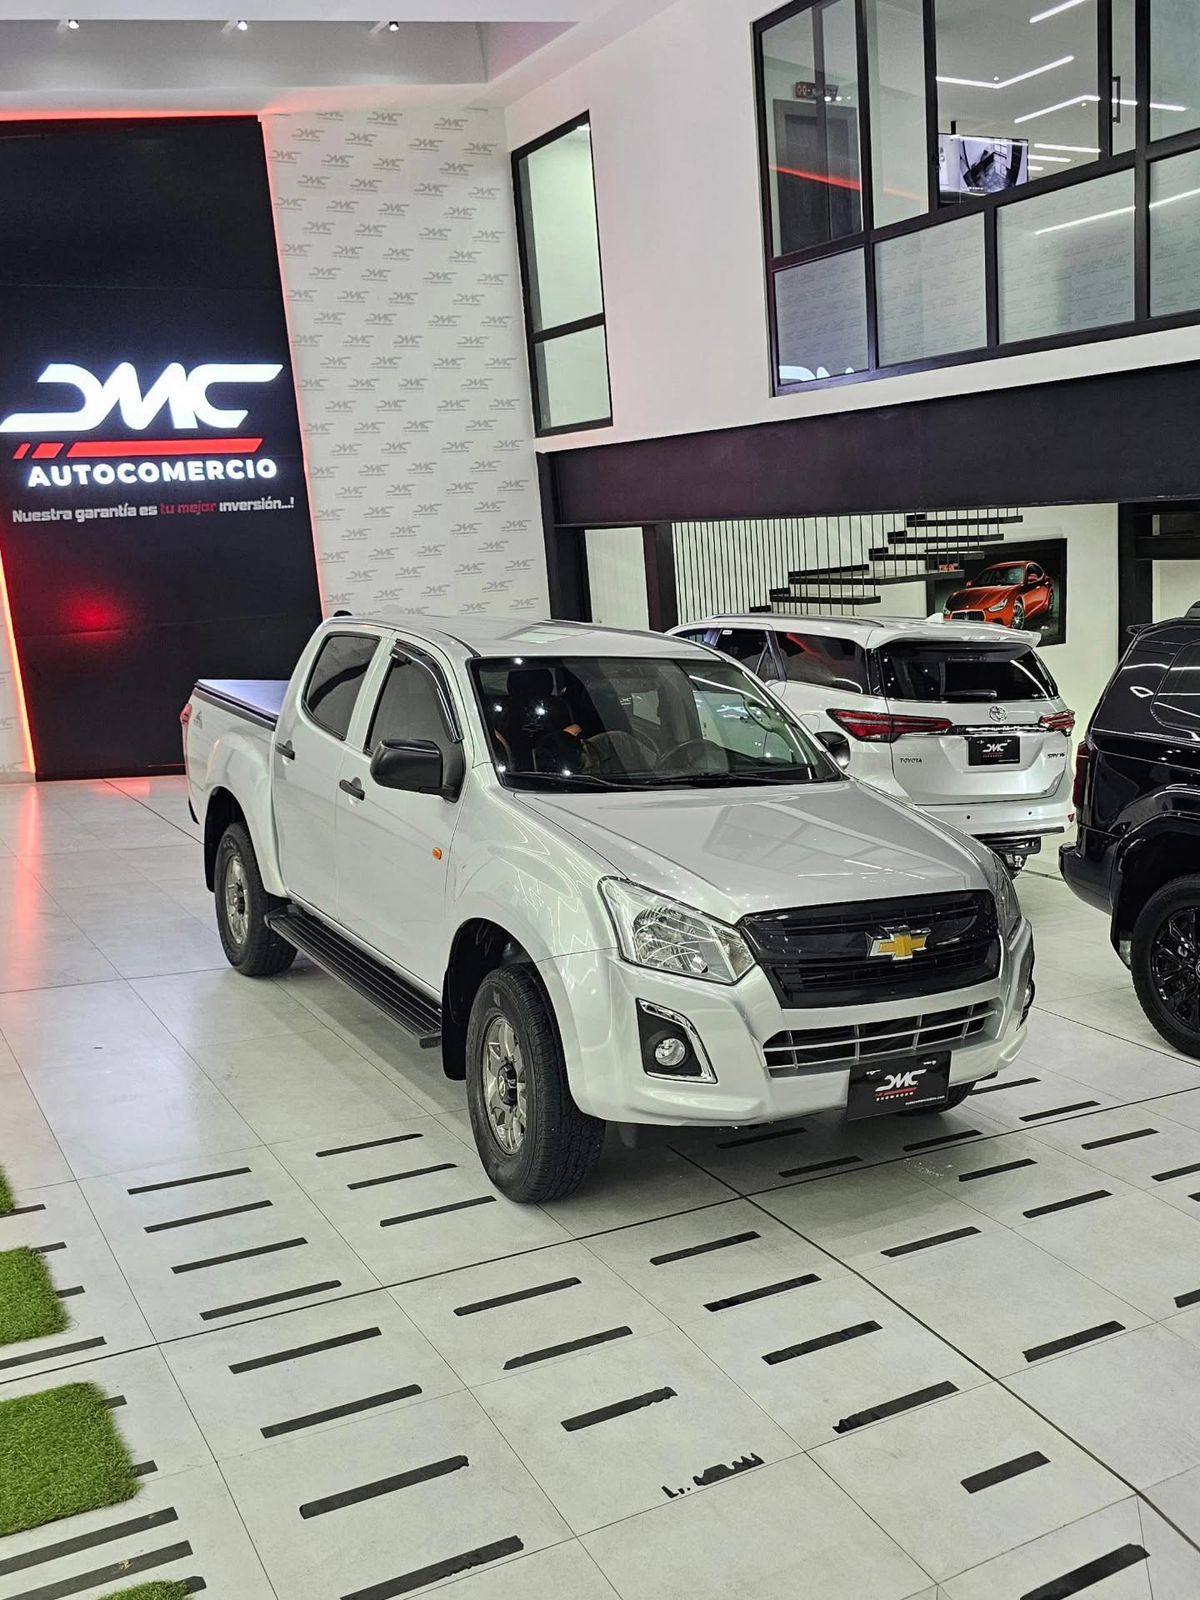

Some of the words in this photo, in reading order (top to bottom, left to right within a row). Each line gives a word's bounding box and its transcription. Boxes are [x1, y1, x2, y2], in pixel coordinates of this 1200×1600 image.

[367, 111, 403, 122] DMC
[434, 117, 468, 128] DMC
[291, 128, 325, 139] DMC
[344, 132, 377, 144] DMC
[408, 138, 445, 149] DMC
[462, 142, 497, 154] DMC
[320, 154, 354, 165] DMC
[373, 158, 404, 169] DMC
[439, 162, 474, 173] DMC
[297, 175, 330, 186] DMC
[350, 178, 383, 189] DMC
[414, 183, 448, 195] DMC
[468, 187, 500, 197] DMC
[275, 197, 306, 208] DMC
[326, 200, 360, 210] DMC
[377, 203, 410, 213] DMC
[443, 207, 477, 217] DMC
[303, 221, 336, 232] DMC
[355, 224, 387, 235] DMC
[418, 227, 452, 238] DMC
[472, 230, 504, 240] DMC
[280, 244, 312, 254] DMC
[332, 245, 364, 256] DMC
[383, 248, 414, 258] DMC
[448, 250, 481, 260] DMC
[308, 267, 342, 277] DMC
[360, 269, 392, 279] DMC
[422, 272, 457, 281] DMC
[477, 273, 508, 282] DMC
[286, 290, 320, 299] DMC
[337, 291, 369, 300] DMC
[388, 292, 419, 302] DMC
[452, 293, 485, 303] DMC
[314, 312, 346, 322] DMC
[364, 313, 397, 323] DMC
[427, 315, 462, 324] DMC
[480, 316, 512, 325] DMC
[292, 335, 324, 344] DMC
[343, 335, 374, 344] DMC
[392, 335, 424, 345] DMC
[456, 336, 489, 345] DMC
[320, 356, 352, 366] DMC
[370, 356, 402, 366] DMC
[432, 357, 466, 366] DMC
[485, 357, 517, 367] DMC
[297, 379, 328, 388] DMC
[347, 378, 380, 388] DMC
[398, 378, 429, 387] DMC
[461, 378, 493, 388] DMC
[0, 362, 283, 432] DMC
[325, 400, 357, 410] DMC
[376, 400, 407, 409] DMC
[437, 400, 470, 409] DMC
[489, 398, 520, 408] DMC
[303, 423, 335, 432] DMC
[354, 422, 385, 431] DMC
[403, 420, 433, 429] DMC
[464, 420, 498, 428] DMC
[330, 443, 362, 453] DMC
[380, 442, 411, 451] DMC
[440, 441, 474, 450] DMC
[493, 440, 524, 449] DMC
[358, 464, 390, 473] DMC
[407, 462, 438, 472] DMC
[469, 460, 501, 469] DMC
[28, 458, 277, 487] AUTOCOMERCIO
[309, 466, 340, 475] DMC
[386, 484, 416, 493] DMC
[446, 482, 479, 492] DMC
[498, 480, 529, 489] DMC
[336, 486, 367, 495] DMC
[363, 506, 395, 515] DMC
[412, 504, 442, 513] DMC
[473, 501, 506, 510] DMC
[12, 508, 73, 523] Nuestra
[75, 502, 137, 522] garantía
[139, 505, 158, 516] es
[160, 503, 175, 515] tu
[178, 500, 217, 515] mejor
[314, 509, 345, 518] DMC
[451, 522, 483, 533] DMC
[501, 519, 532, 529] DMC
[341, 528, 372, 538] DMC
[391, 525, 421, 535] DMC
[417, 544, 446, 554] DMC
[478, 541, 509, 550] DMC
[319, 551, 350, 562] DMC
[368, 547, 400, 557] DMC
[454, 562, 486, 572] DMC
[505, 559, 536, 569] DMC
[345, 570, 377, 580] DMC
[395, 566, 425, 576] DMC
[421, 584, 450, 594] DMC
[482, 579, 514, 590] DMC
[325, 593, 355, 602] DMC
[373, 588, 405, 598] DMC
[459, 602, 491, 611] DMC
[509, 597, 539, 607] DMC
[982, 743, 1008, 752] DMC
[875, 1068, 927, 1092] DMC
